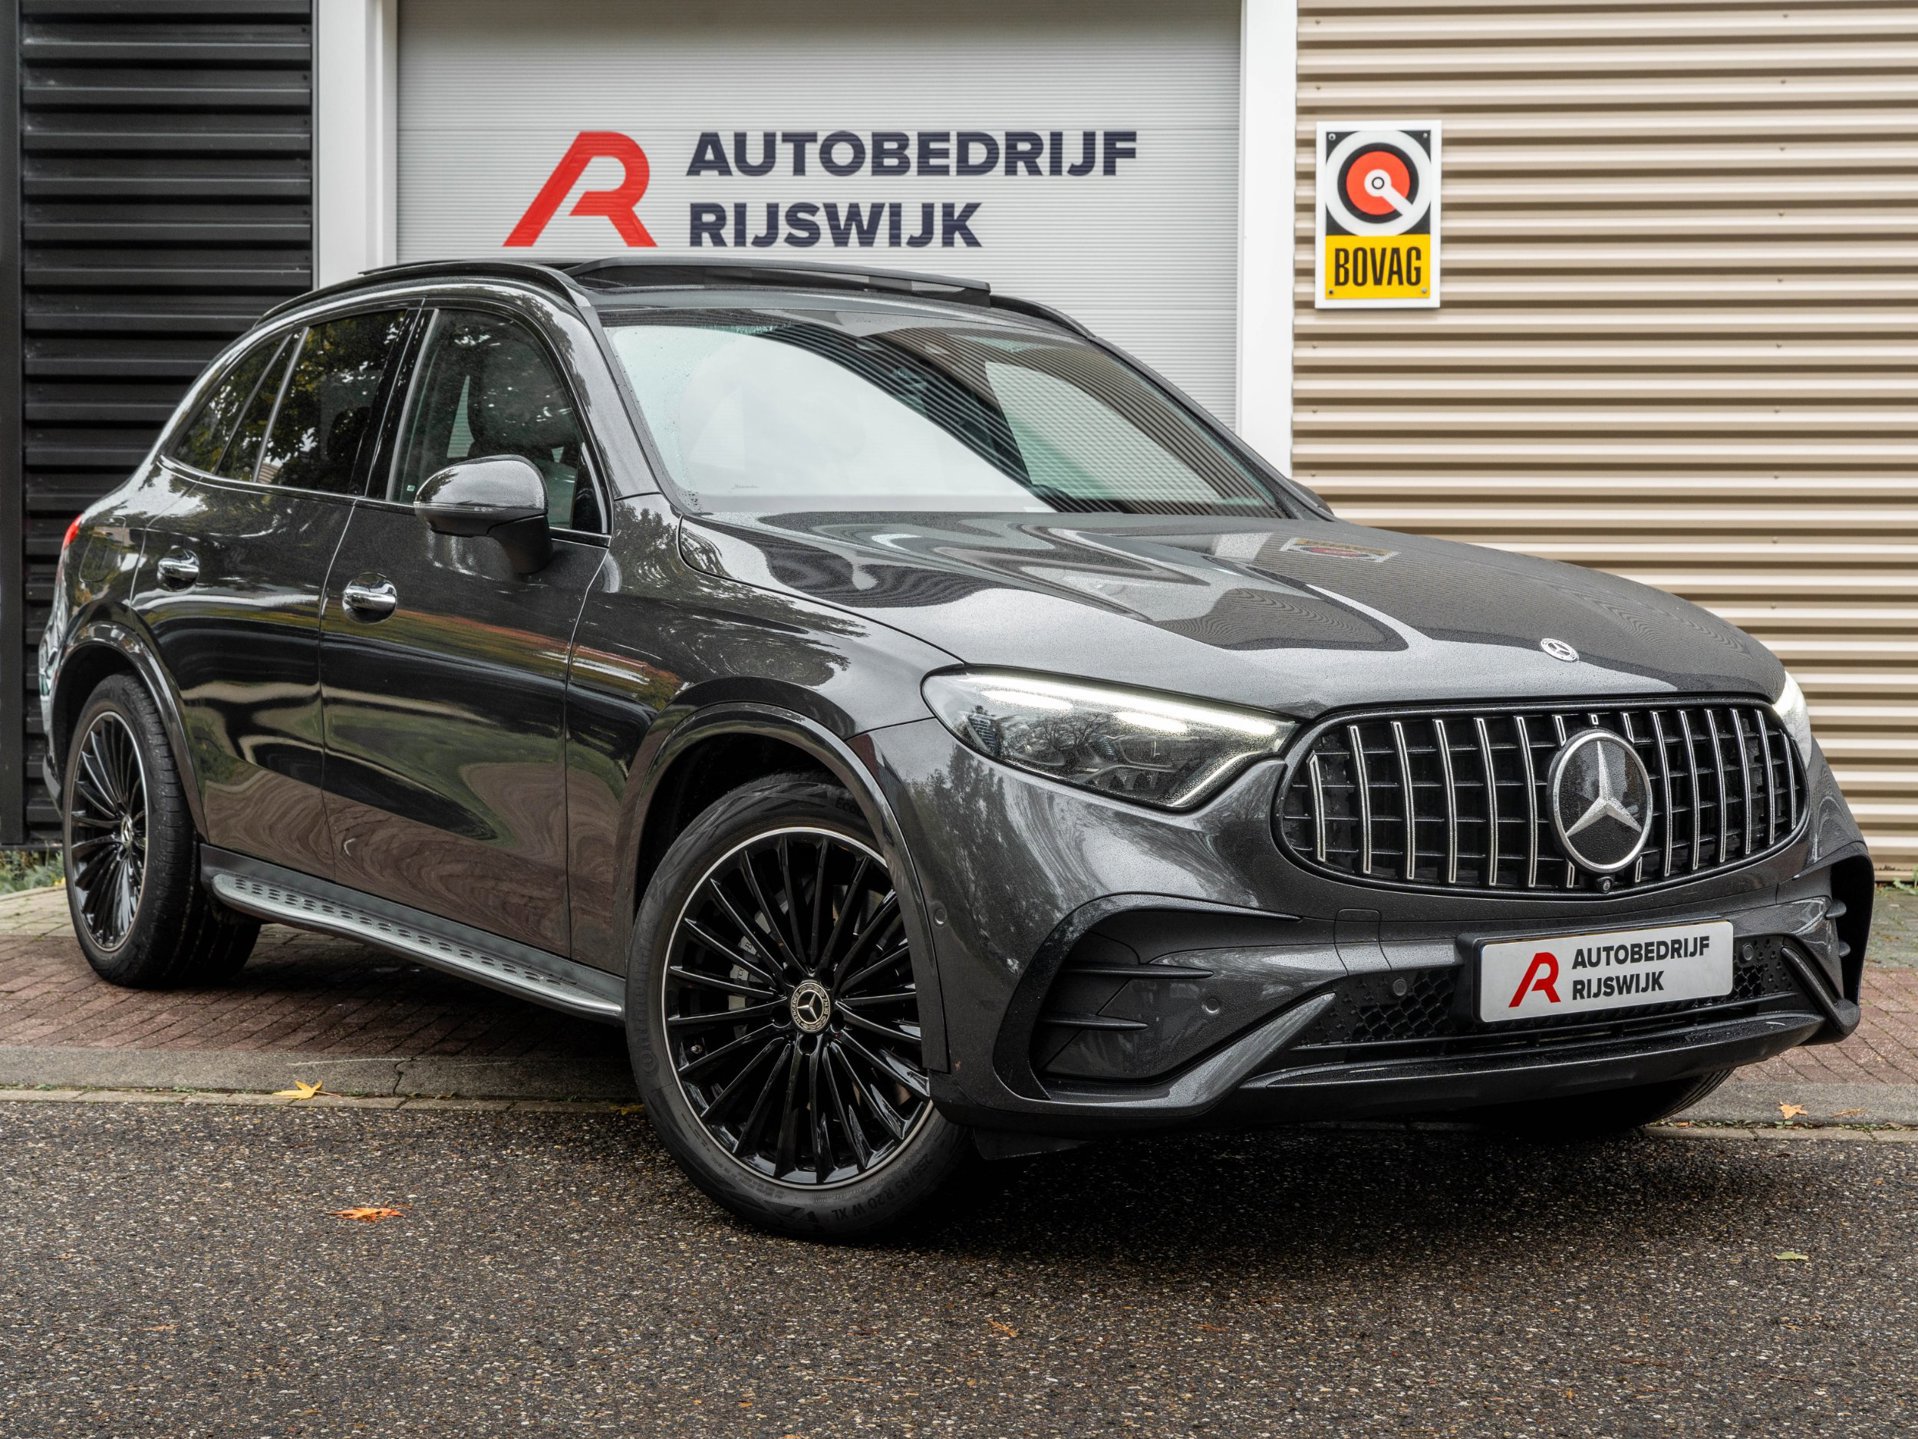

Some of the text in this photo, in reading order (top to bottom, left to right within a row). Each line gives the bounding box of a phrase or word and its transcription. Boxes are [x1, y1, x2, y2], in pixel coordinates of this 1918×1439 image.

[686, 131, 1137, 176] AUTOBEDRIJF
[689, 202, 982, 248] RIJSWIJK
[1334, 246, 1422, 287] BOVAG
[1571, 935, 1710, 970] AUTOBEDRIJF
[1571, 970, 1665, 1001] RIJSWIJK
[831, 1207, 849, 1221] XL
[867, 1188, 895, 1209] R20
